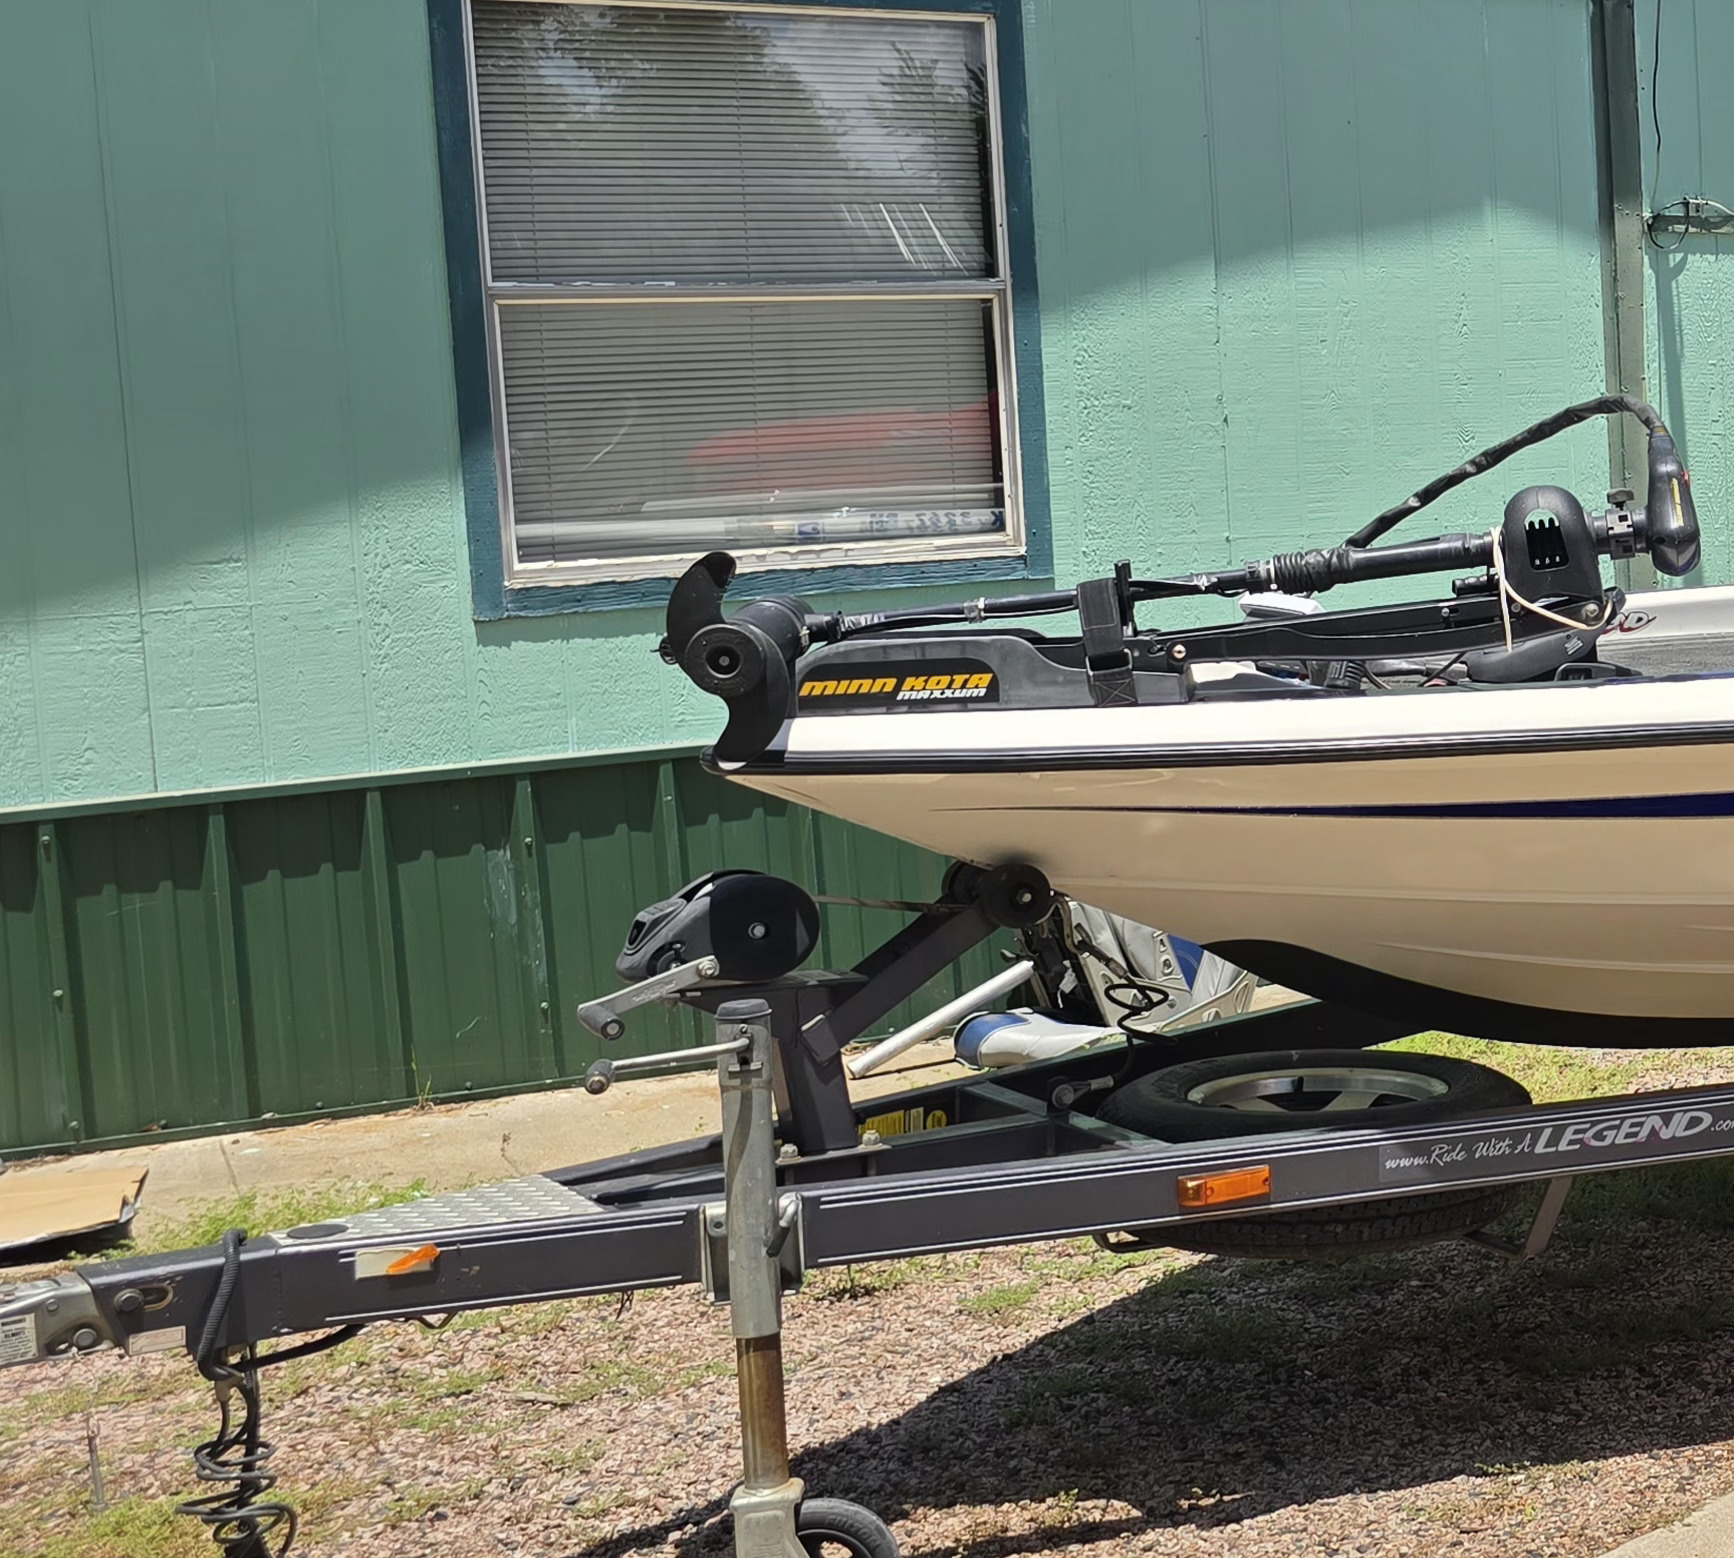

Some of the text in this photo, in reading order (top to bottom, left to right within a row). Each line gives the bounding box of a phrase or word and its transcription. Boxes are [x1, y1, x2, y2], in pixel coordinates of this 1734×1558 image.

[901, 672, 994, 691] KOTA
[896, 687, 987, 701] MAXXUM
[1384, 1143, 1468, 1170] www.Ride
[1472, 1137, 1513, 1160] With
[1514, 1131, 1533, 1154] A
